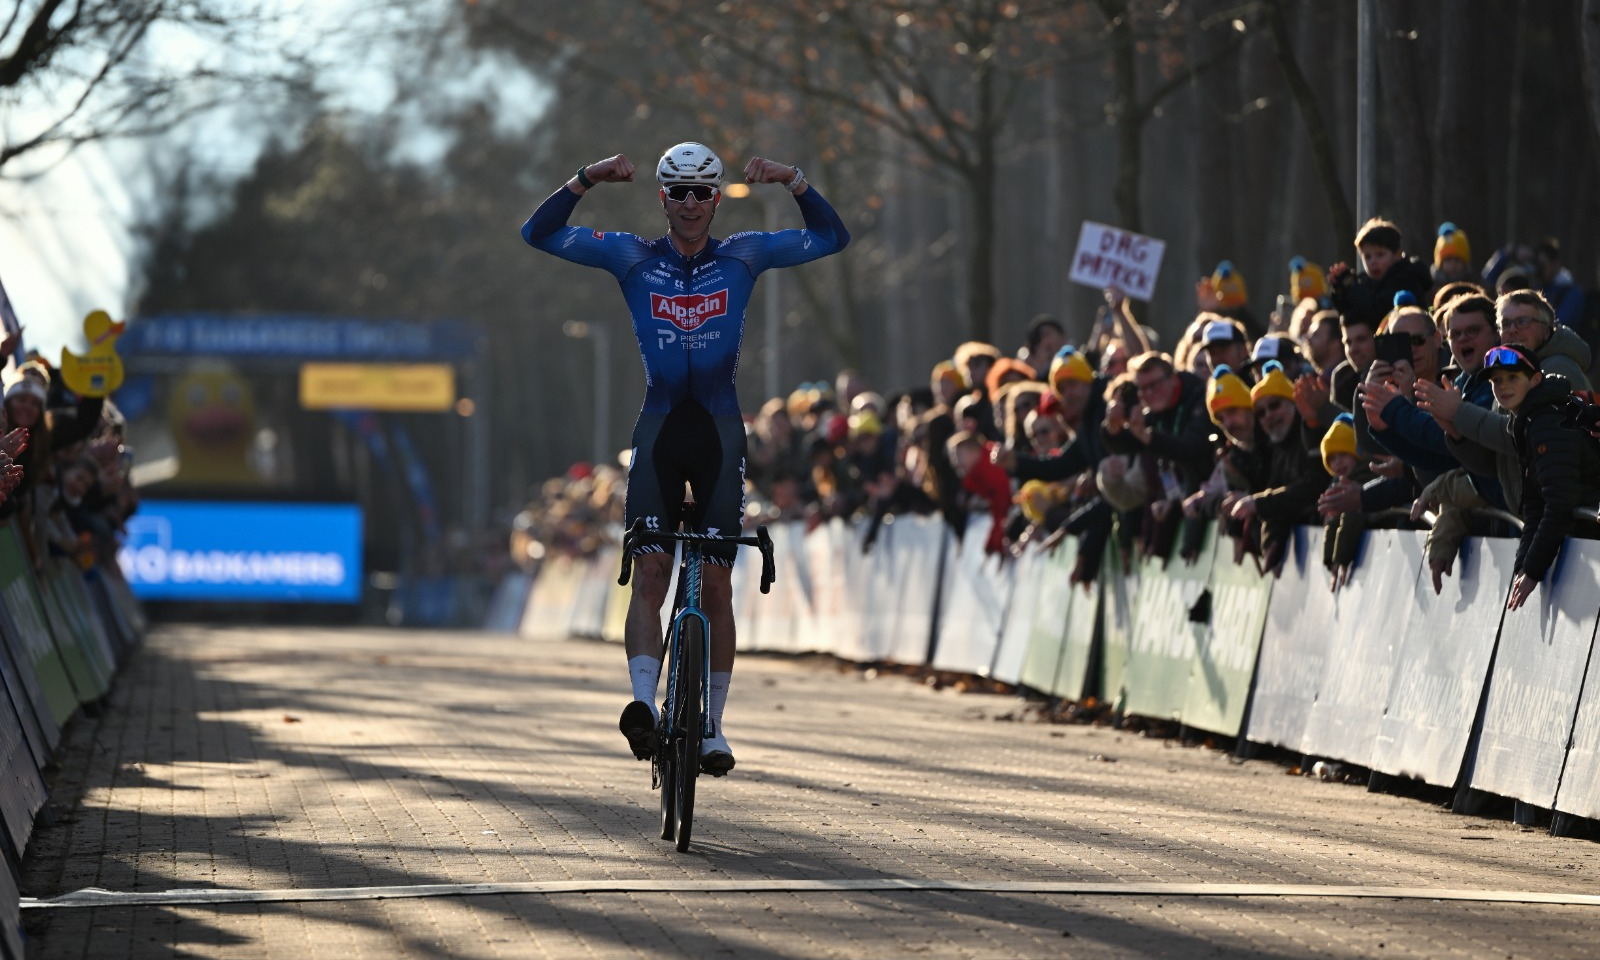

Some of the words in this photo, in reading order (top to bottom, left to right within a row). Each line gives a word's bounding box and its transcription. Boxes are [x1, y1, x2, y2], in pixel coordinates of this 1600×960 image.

[658, 298, 720, 320] Alpecin
[680, 331, 721, 342] PREMIER
[681, 342, 706, 350] TECH
[686, 557, 694, 599] CANYON
